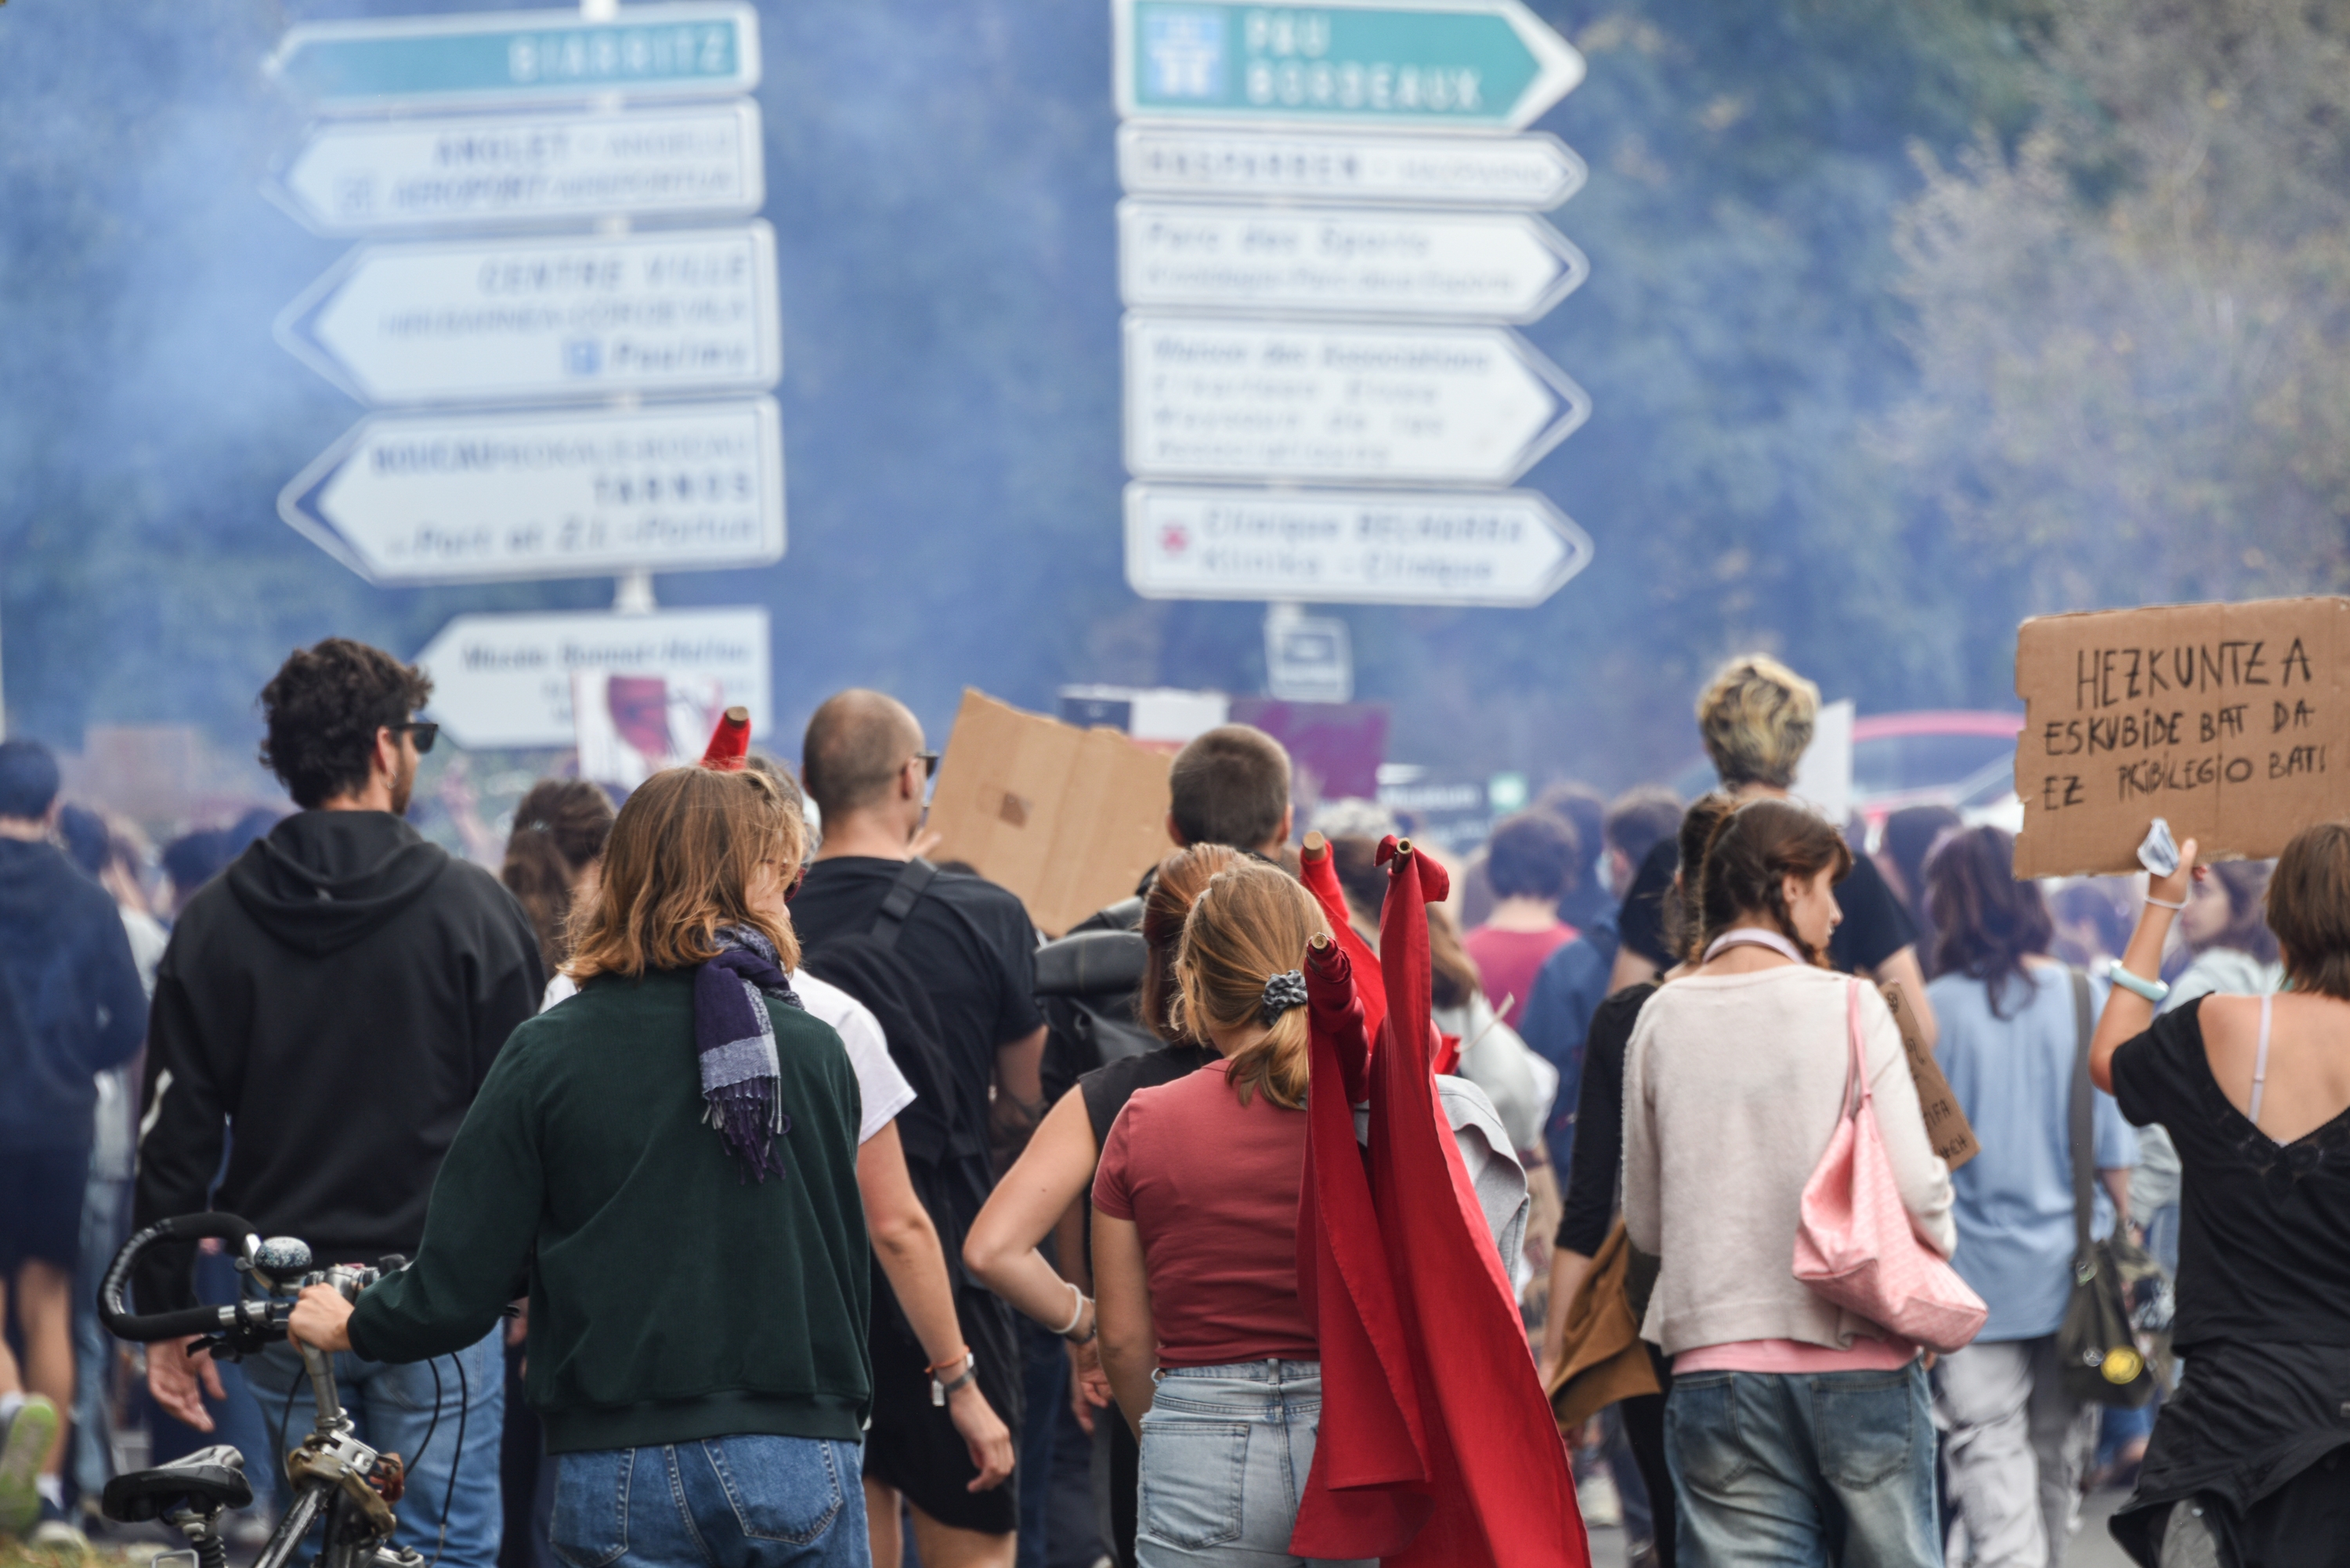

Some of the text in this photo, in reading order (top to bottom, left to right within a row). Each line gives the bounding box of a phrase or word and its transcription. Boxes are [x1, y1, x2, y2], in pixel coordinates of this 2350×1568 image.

[510, 27, 730, 80] BIARRITZ
[1247, 12, 1329, 56] PAU
[1248, 60, 1481, 110] BORDEAUX
[2200, 705, 2249, 743] BAT
[2272, 698, 2316, 734] DA
[2043, 775, 2087, 811] EZ
